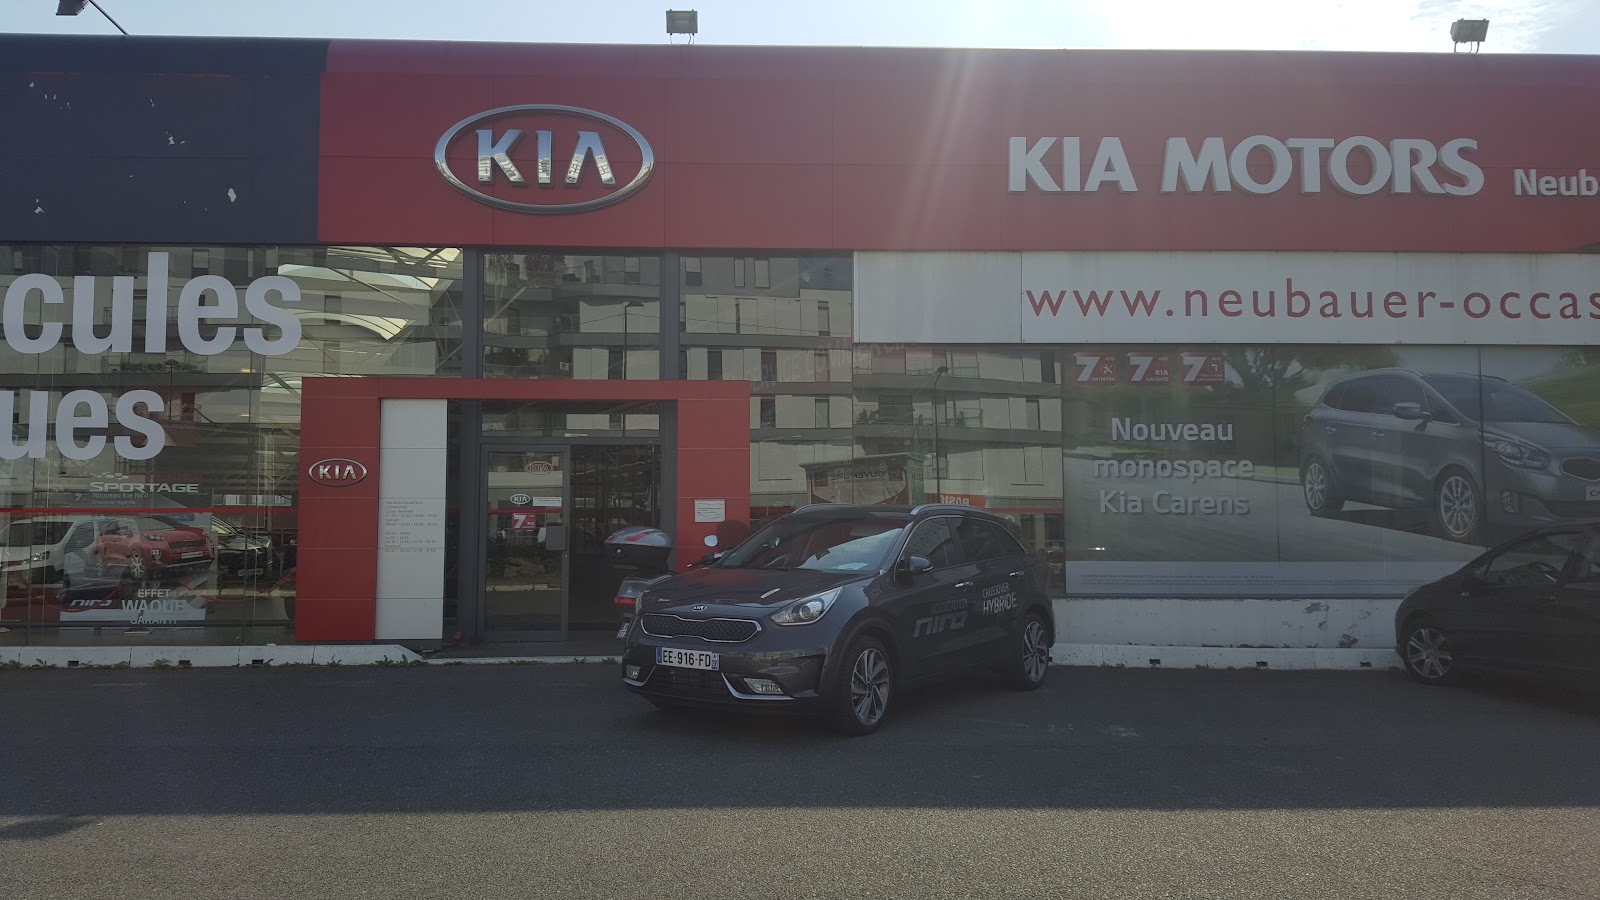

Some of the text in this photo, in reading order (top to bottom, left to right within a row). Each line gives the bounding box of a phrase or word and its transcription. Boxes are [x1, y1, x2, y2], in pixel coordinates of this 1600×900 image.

[476, 129, 616, 185] KIA
[1008, 135, 1485, 197] KIA MOTORS
[1513, 168, 1599, 196] Neub
[2, 251, 302, 356] cules
[1076, 357, 1100, 381] 7
[1129, 357, 1153, 381] 7
[1183, 357, 1207, 381] 7
[0, 389, 165, 461] ues
[1110, 417, 1234, 442] Nouveau
[319, 464, 357, 480] KIA
[1093, 458, 1255, 483] monospace
[89, 481, 200, 494] SPORTAGE
[1100, 490, 1250, 514] Kia Carens
[513, 514, 528, 529] 7
[138, 589, 171, 598] EFFET
[982, 582, 1010, 599] CROSSOVER
[982, 592, 1018, 617] HYBRIDE
[663, 650, 711, 667] EE-916-FD
